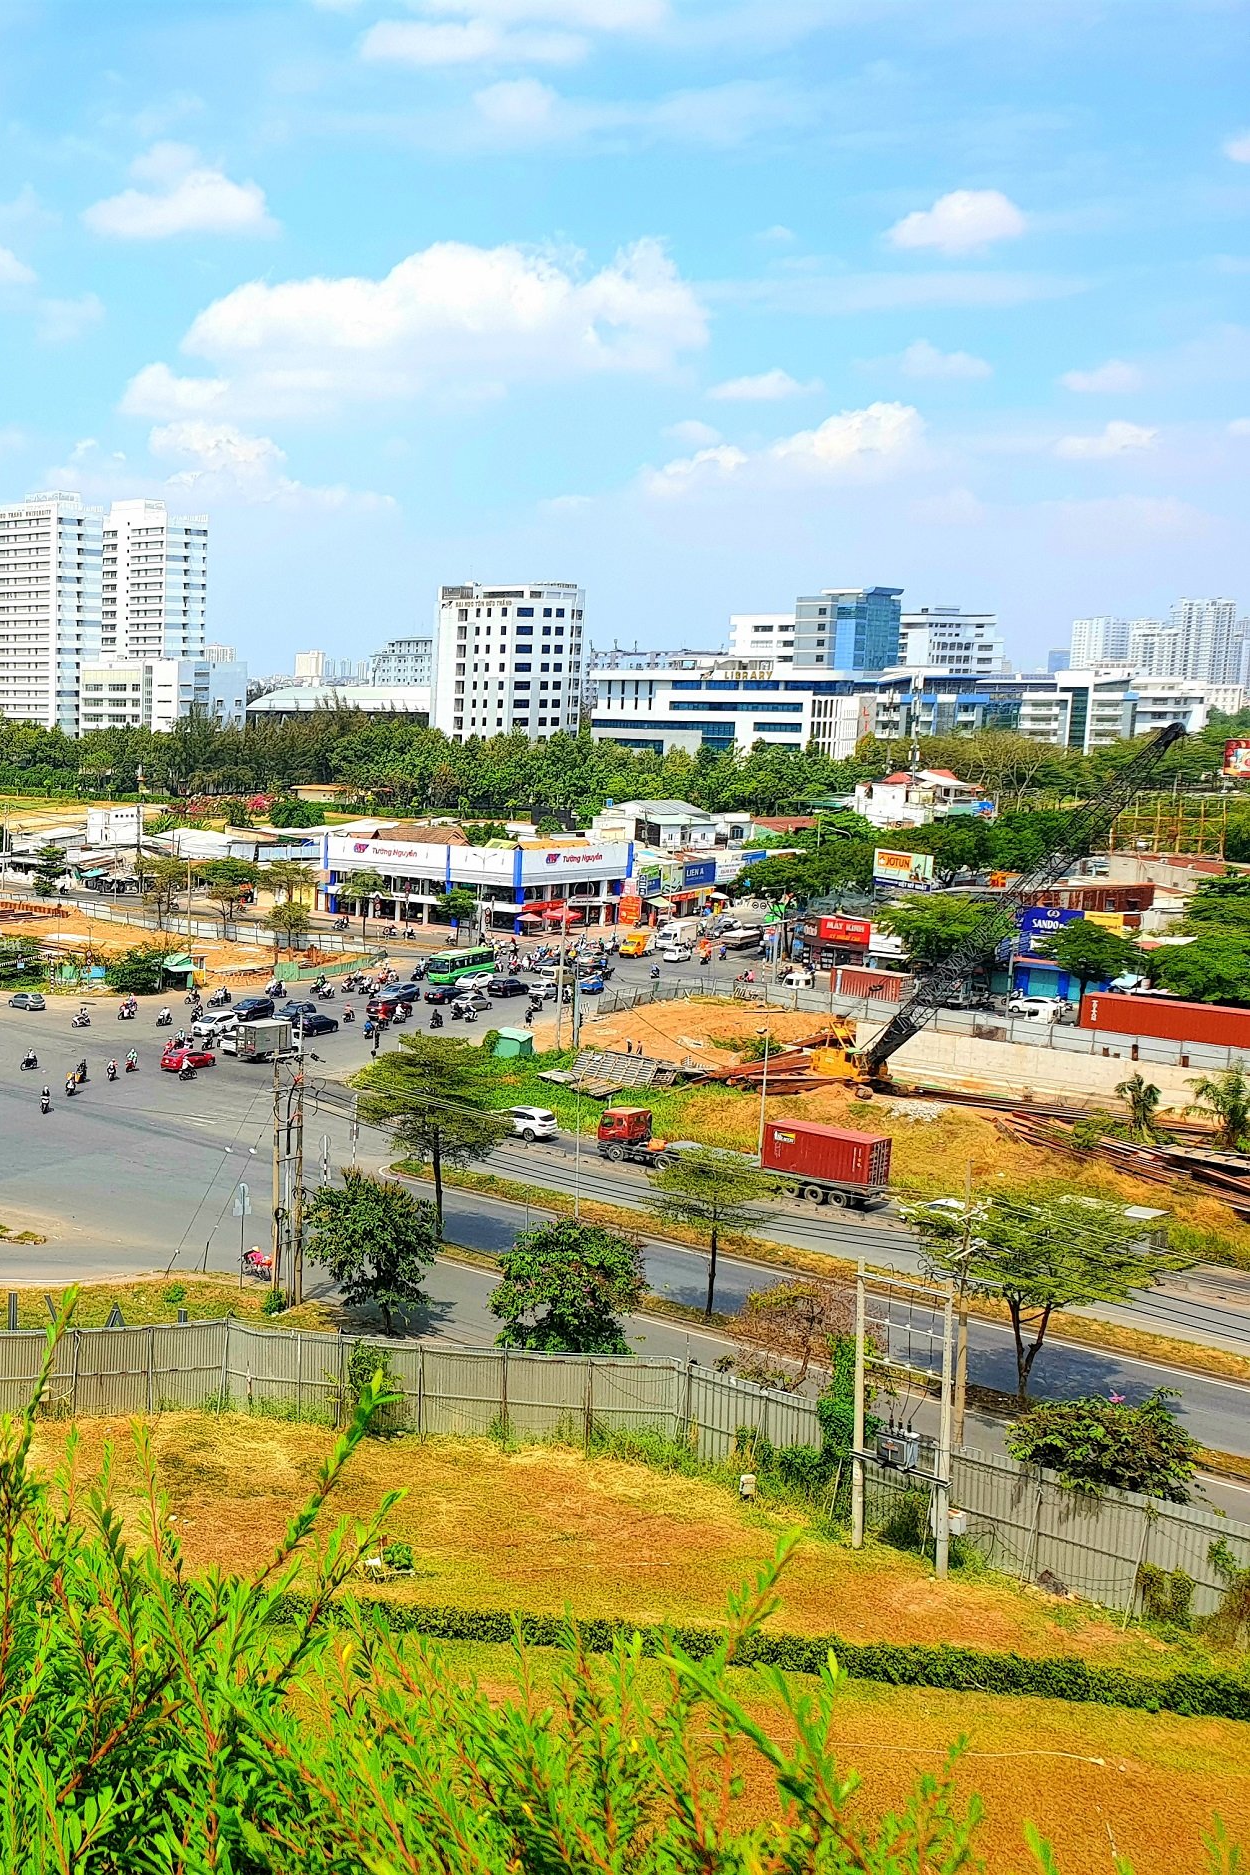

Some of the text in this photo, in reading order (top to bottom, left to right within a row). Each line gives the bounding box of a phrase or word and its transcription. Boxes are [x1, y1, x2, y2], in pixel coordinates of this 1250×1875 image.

[724, 671, 773, 680] LIBRARY
[563, 854, 581, 864] Tường
[886, 857, 910, 868] JOTUN
[1032, 919, 1060, 929] SANDO
